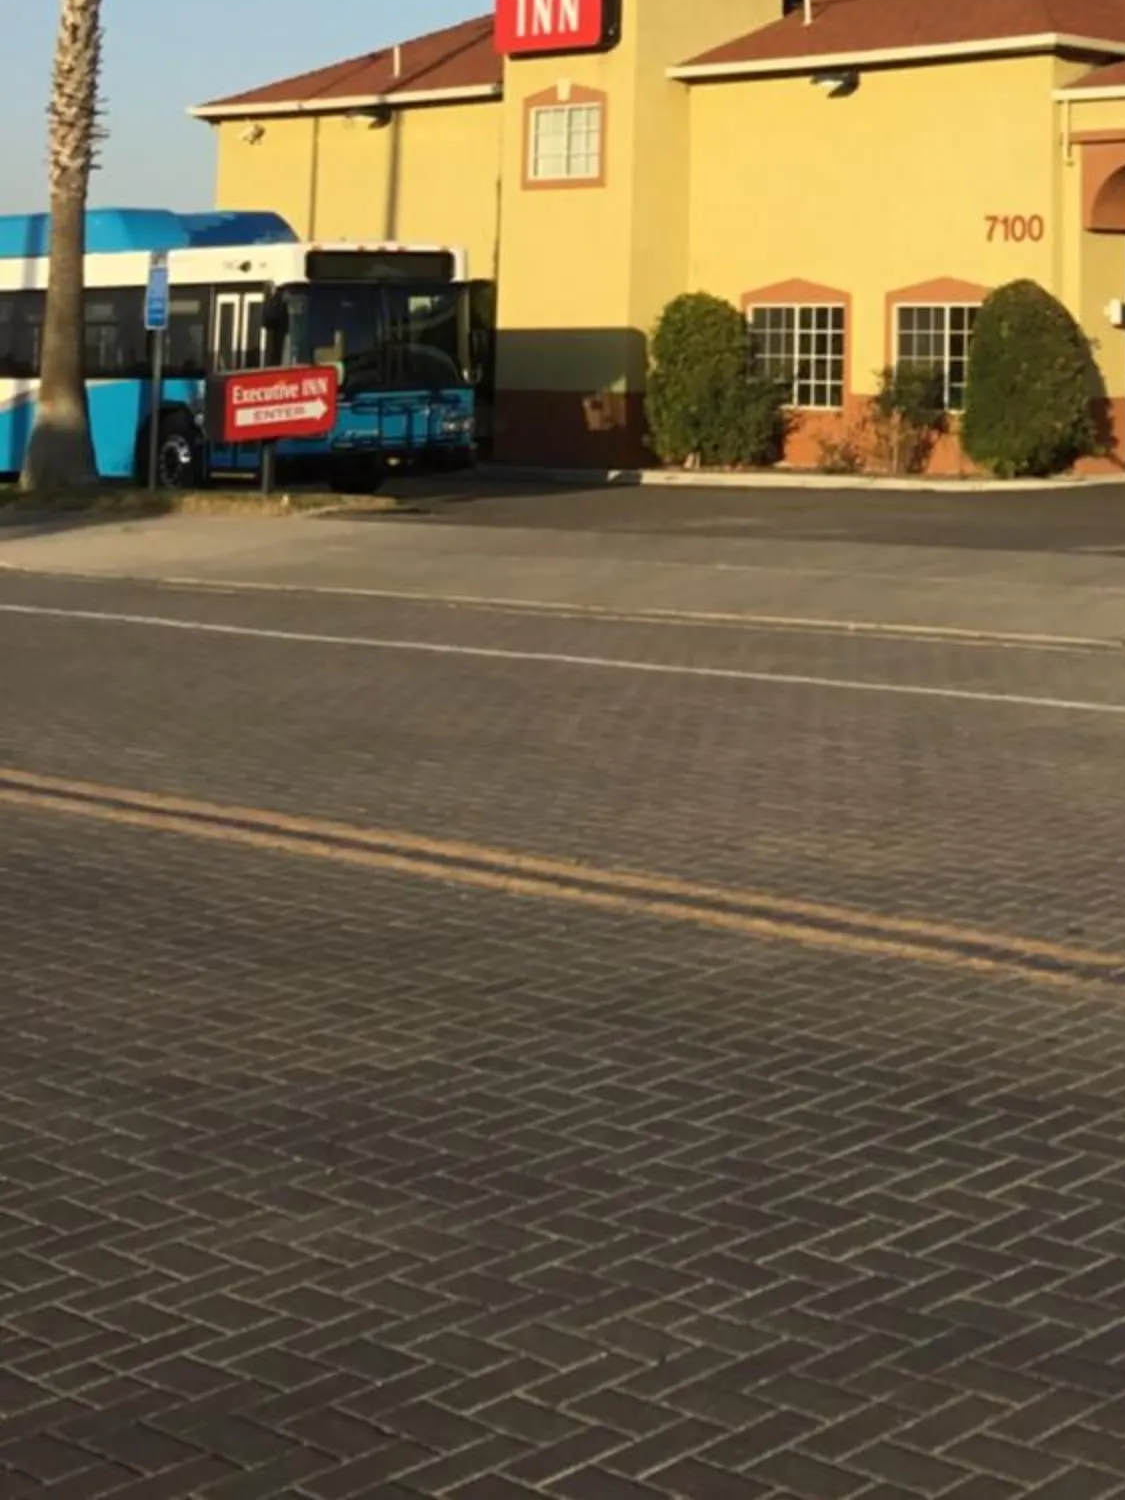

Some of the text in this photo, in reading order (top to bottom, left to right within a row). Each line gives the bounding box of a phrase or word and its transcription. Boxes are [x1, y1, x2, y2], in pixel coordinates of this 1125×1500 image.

[984, 214, 1044, 243] 7100
[232, 377, 328, 405] Executive INN
[253, 406, 306, 422] ENTER
